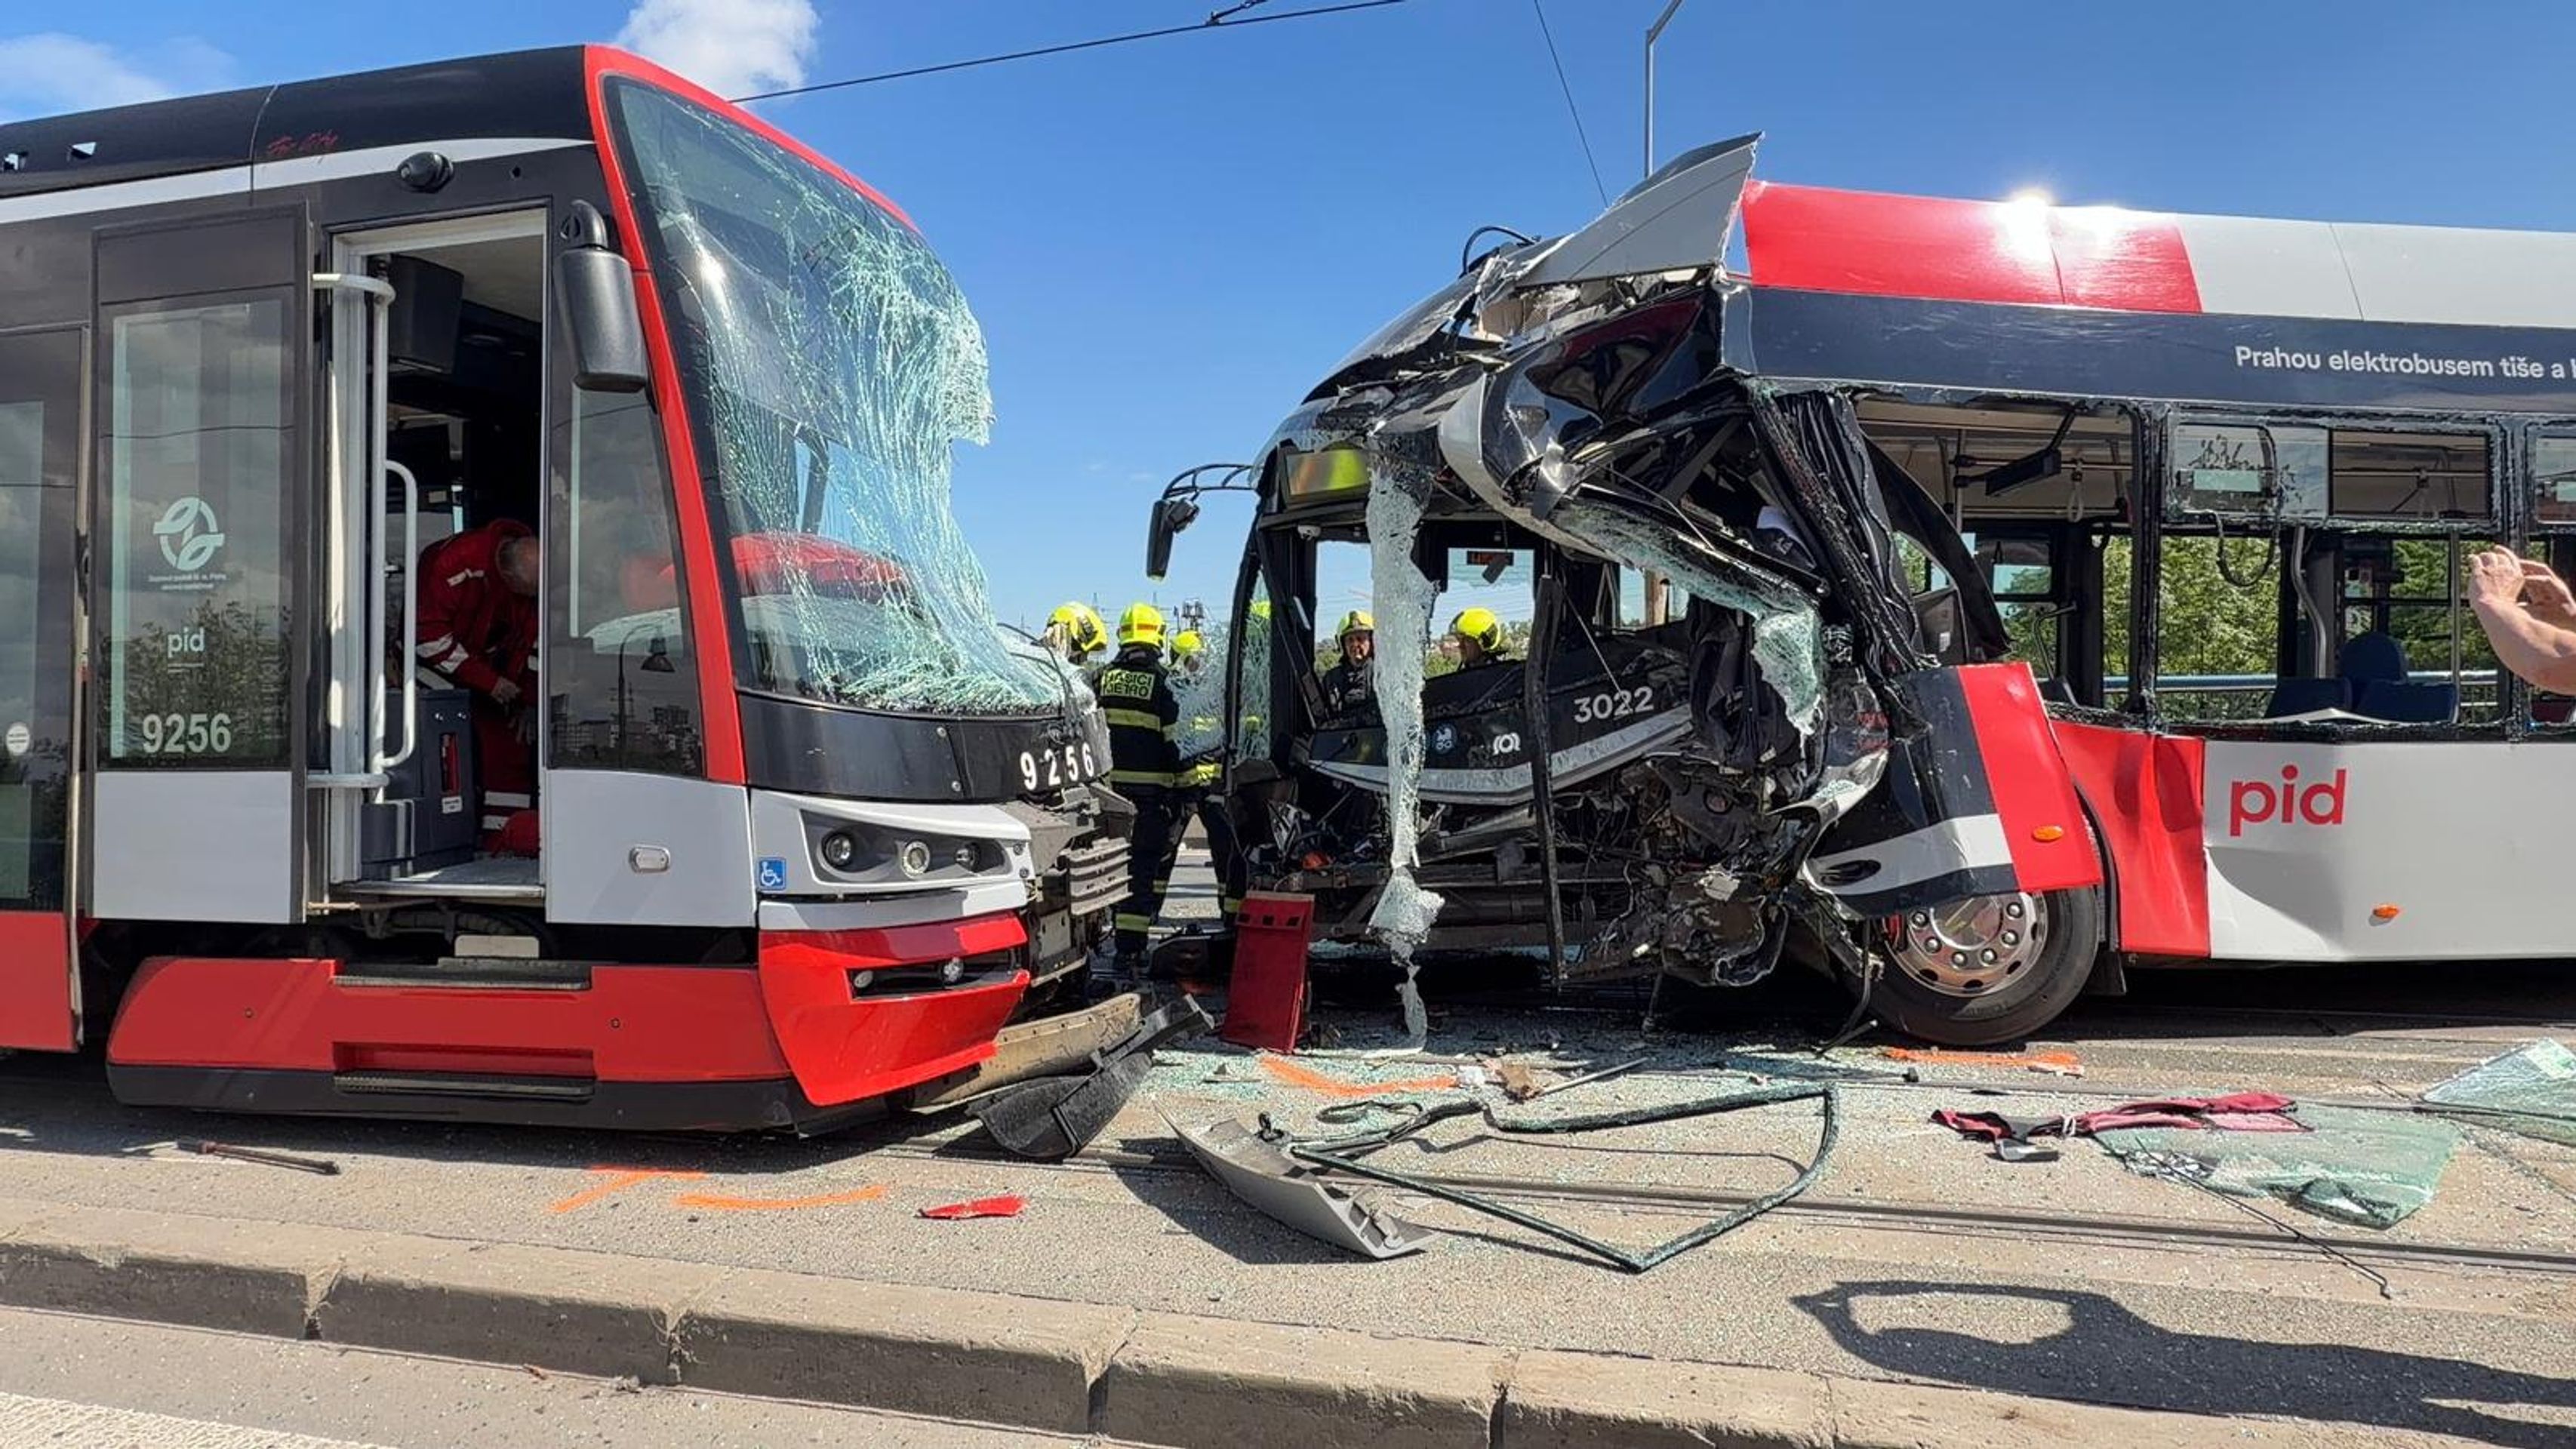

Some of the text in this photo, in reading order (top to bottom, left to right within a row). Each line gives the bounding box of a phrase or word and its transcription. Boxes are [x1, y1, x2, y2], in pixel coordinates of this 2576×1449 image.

[2235, 346, 2322, 370] Prahou
[2328, 349, 2494, 377] elektrobusem
[2499, 355, 2544, 378] tiše
[2550, 363, 2565, 379] a
[167, 626, 205, 658] pid
[1574, 686, 1654, 723] 3022
[143, 712, 231, 753] 9256
[1020, 742, 1094, 791] 9256
[2230, 764, 2347, 837] pid
